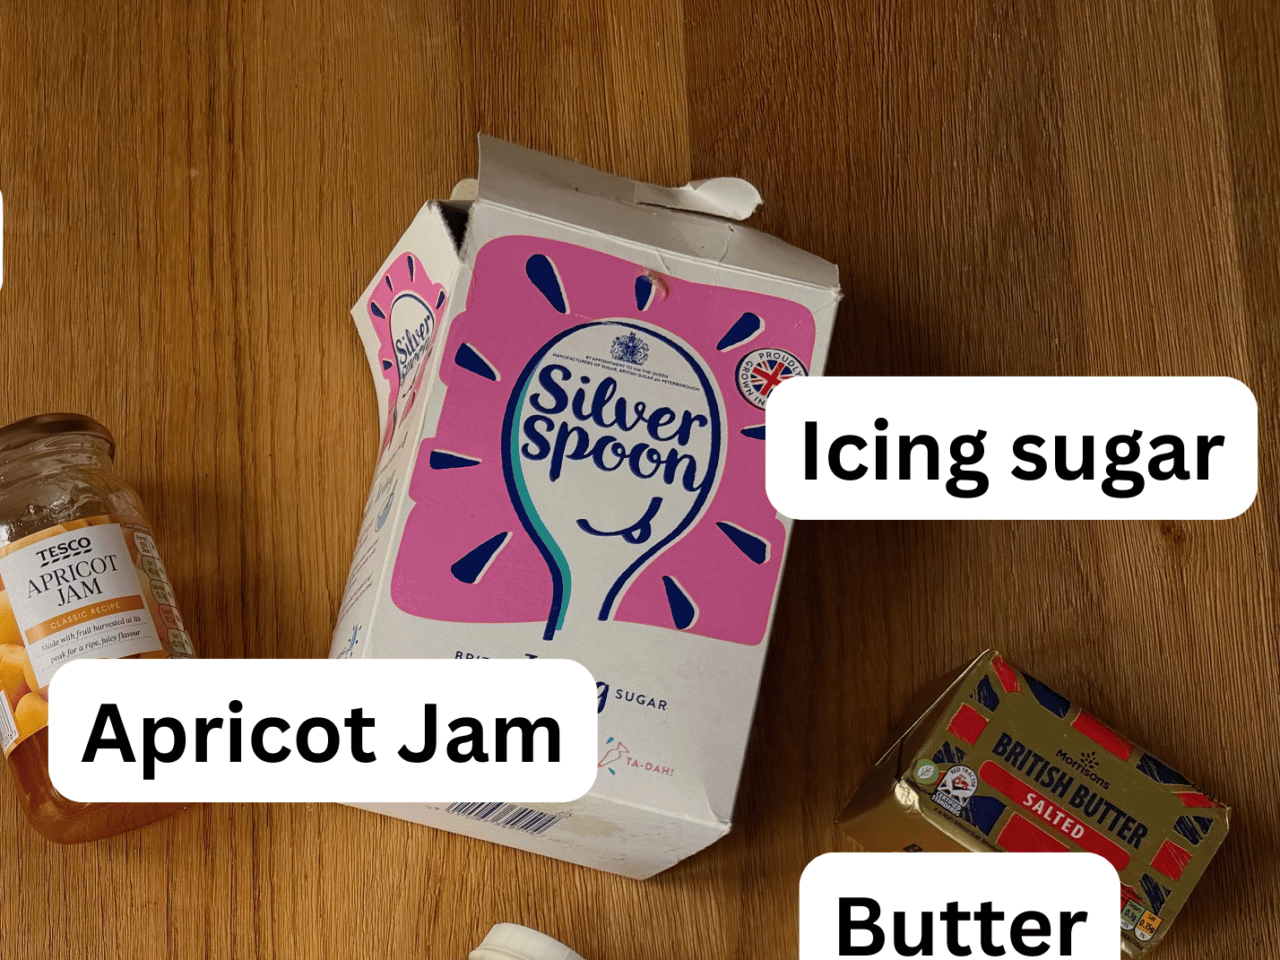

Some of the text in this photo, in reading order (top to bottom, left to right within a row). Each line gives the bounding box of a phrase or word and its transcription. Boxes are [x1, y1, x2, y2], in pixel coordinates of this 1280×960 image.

[758, 351, 802, 378] PROUDLY
[530, 362, 709, 447] Silver
[35, 535, 92, 562] TESCO
[27, 554, 117, 598] APRICOT
[52, 574, 103, 608] JAM
[49, 601, 121, 629] CLASSIC RECIPE
[40, 638, 60, 652] Made
[59, 631, 76, 643] with
[73, 626, 93, 641] fruit
[92, 617, 125, 632] harvested
[125, 616, 132, 624] at
[49, 651, 66, 664] peak
[64, 646, 78, 658] for
[100, 633, 117, 646] juicy
[115, 628, 140, 641] flavour
[614, 688, 668, 711] SUGAR
[625, 757, 674, 776] TA-DAH!
[1054, 748, 1110, 790] Morrisons
[931, 794, 960, 816] STANDARDS
[990, 731, 1075, 800] BRITISH
[1067, 782, 1150, 850] BUTTER
[1022, 791, 1086, 841] SALTED
[1138, 919, 1155, 934] 0.15g
